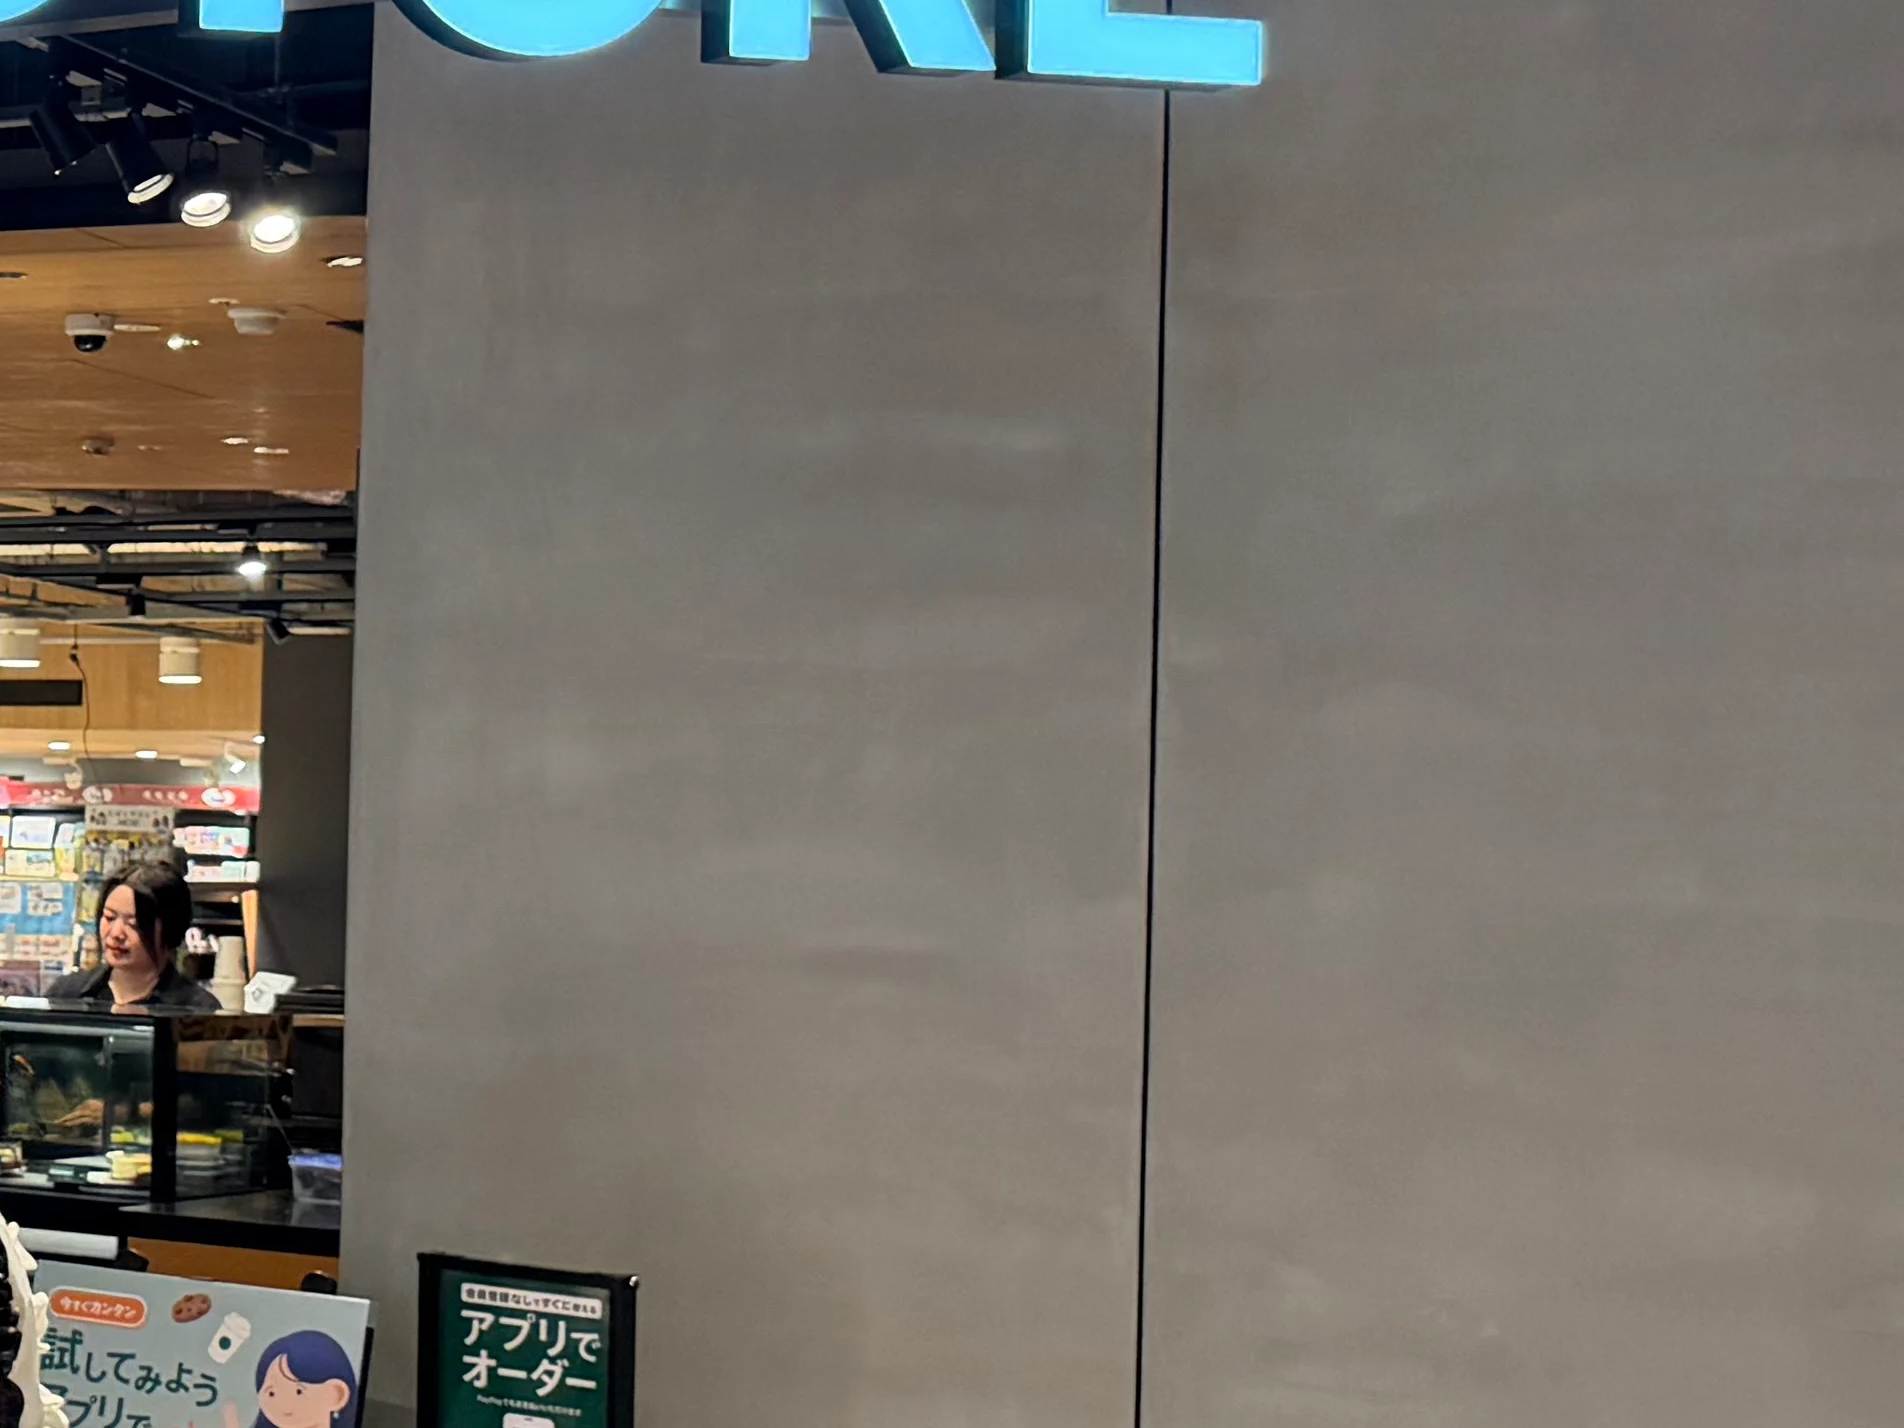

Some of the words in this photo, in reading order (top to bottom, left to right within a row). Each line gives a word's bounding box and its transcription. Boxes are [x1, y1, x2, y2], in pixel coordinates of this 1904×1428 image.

[460, 1309, 602, 1364] アプリで
[461, 1348, 598, 1398] オーダー
